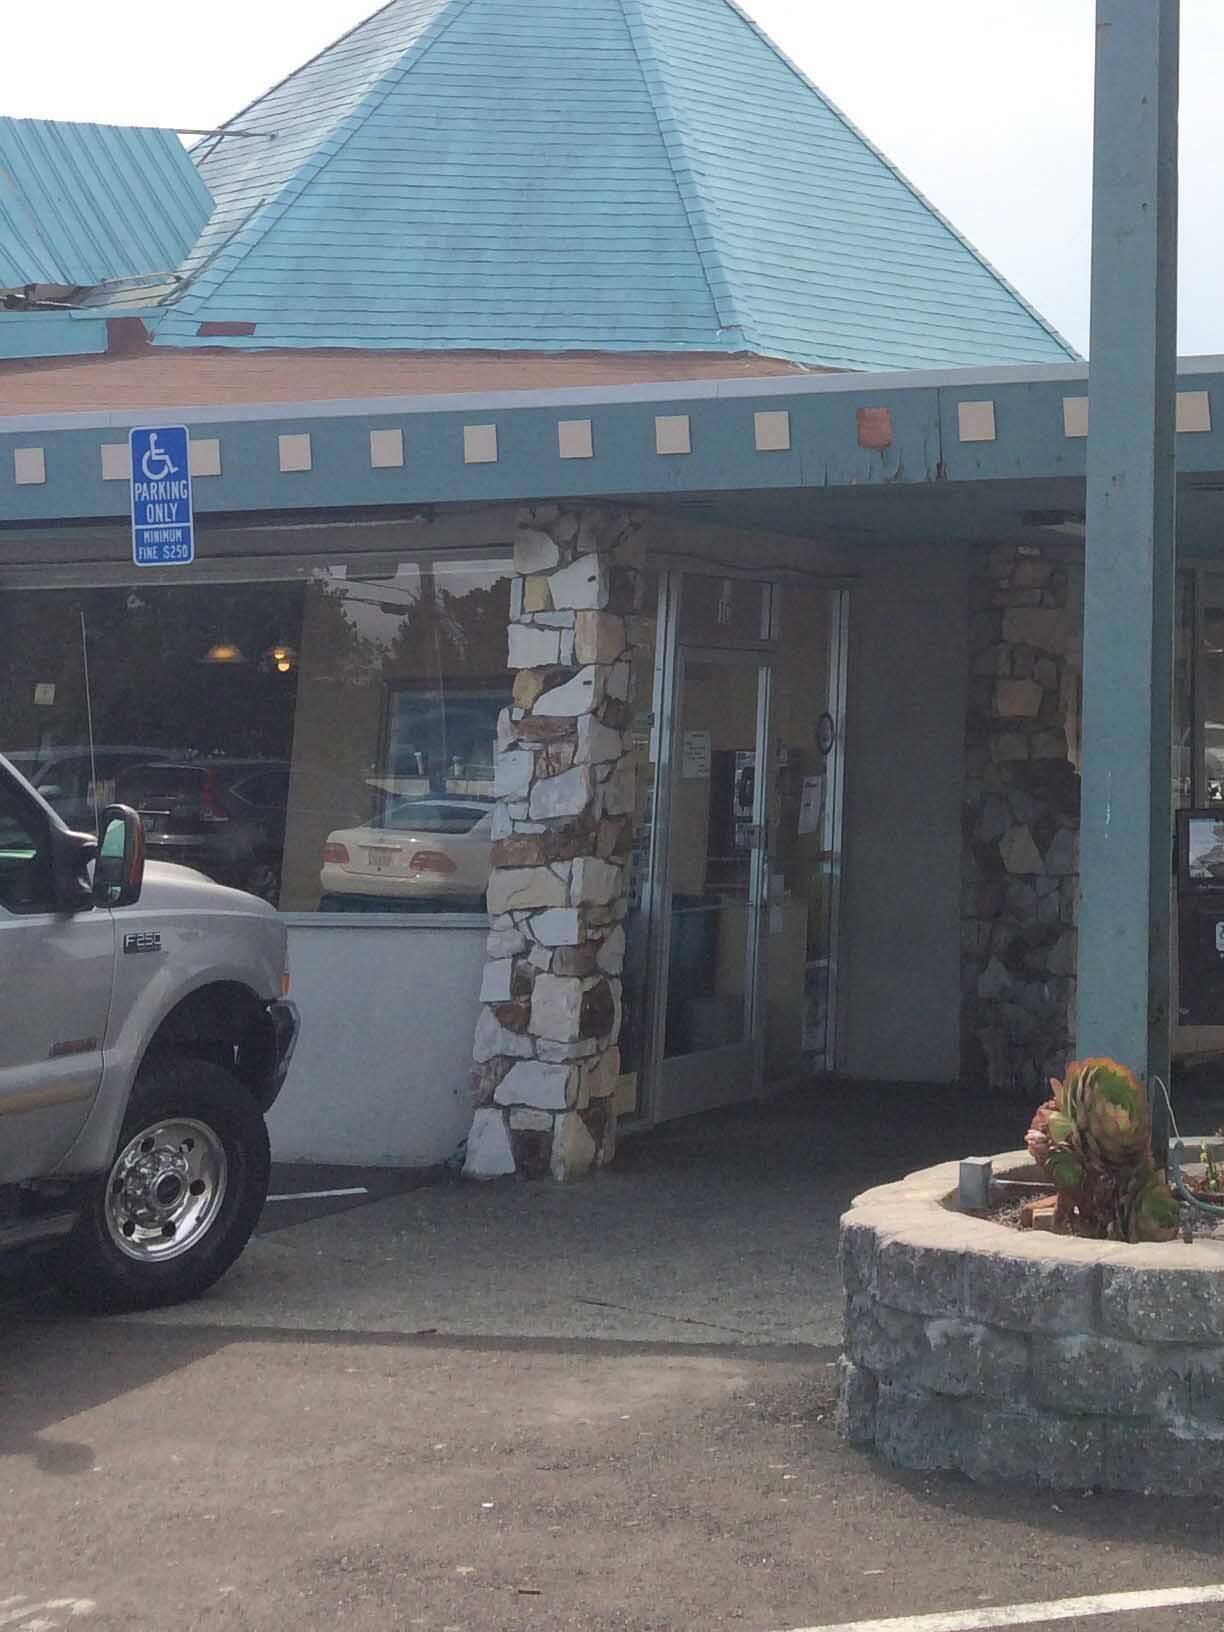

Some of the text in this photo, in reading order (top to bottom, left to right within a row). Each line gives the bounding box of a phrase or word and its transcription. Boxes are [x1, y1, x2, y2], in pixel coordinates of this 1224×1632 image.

[134, 480, 188, 502] PARKING
[146, 503, 178, 523] ONLY
[143, 528, 183, 544] MINIMUM
[139, 545, 188, 559] FINE $250
